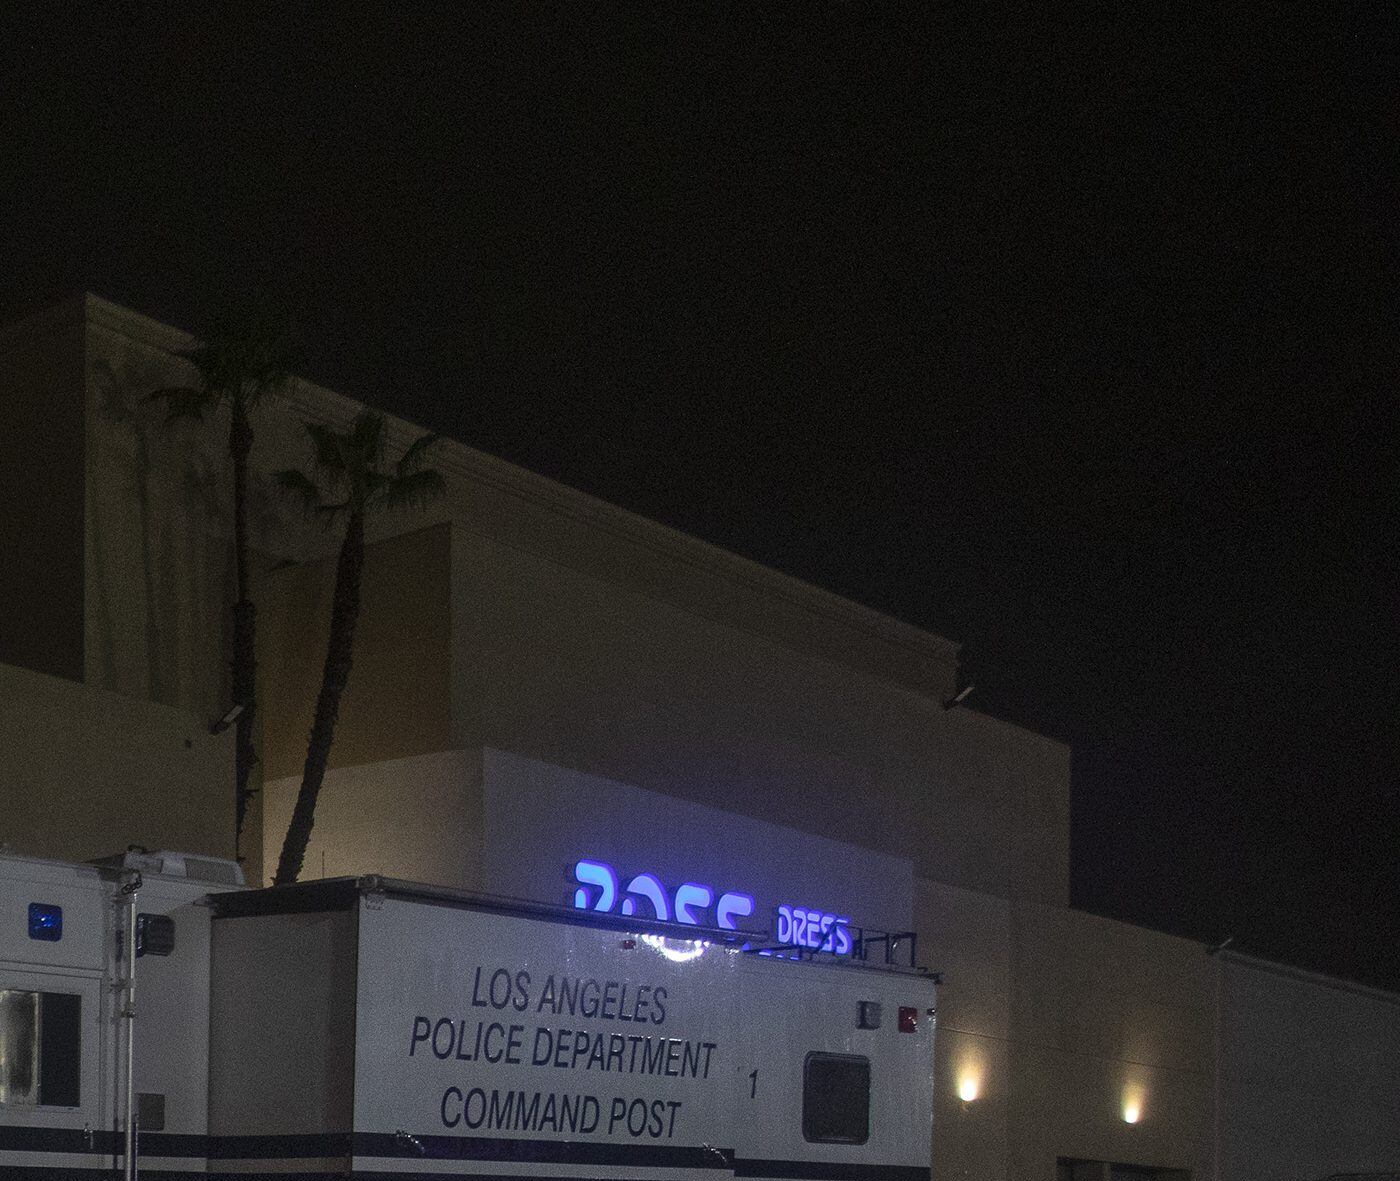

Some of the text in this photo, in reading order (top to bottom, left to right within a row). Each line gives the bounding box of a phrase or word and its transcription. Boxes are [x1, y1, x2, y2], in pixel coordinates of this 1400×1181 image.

[777, 904, 854, 955] DRESS
[471, 966, 669, 1026] LOS ANGELES
[408, 1015, 718, 1080] POLICE DEPARTMENT
[748, 1068, 760, 1100] 1
[440, 1086, 683, 1139] COMMAND POST
